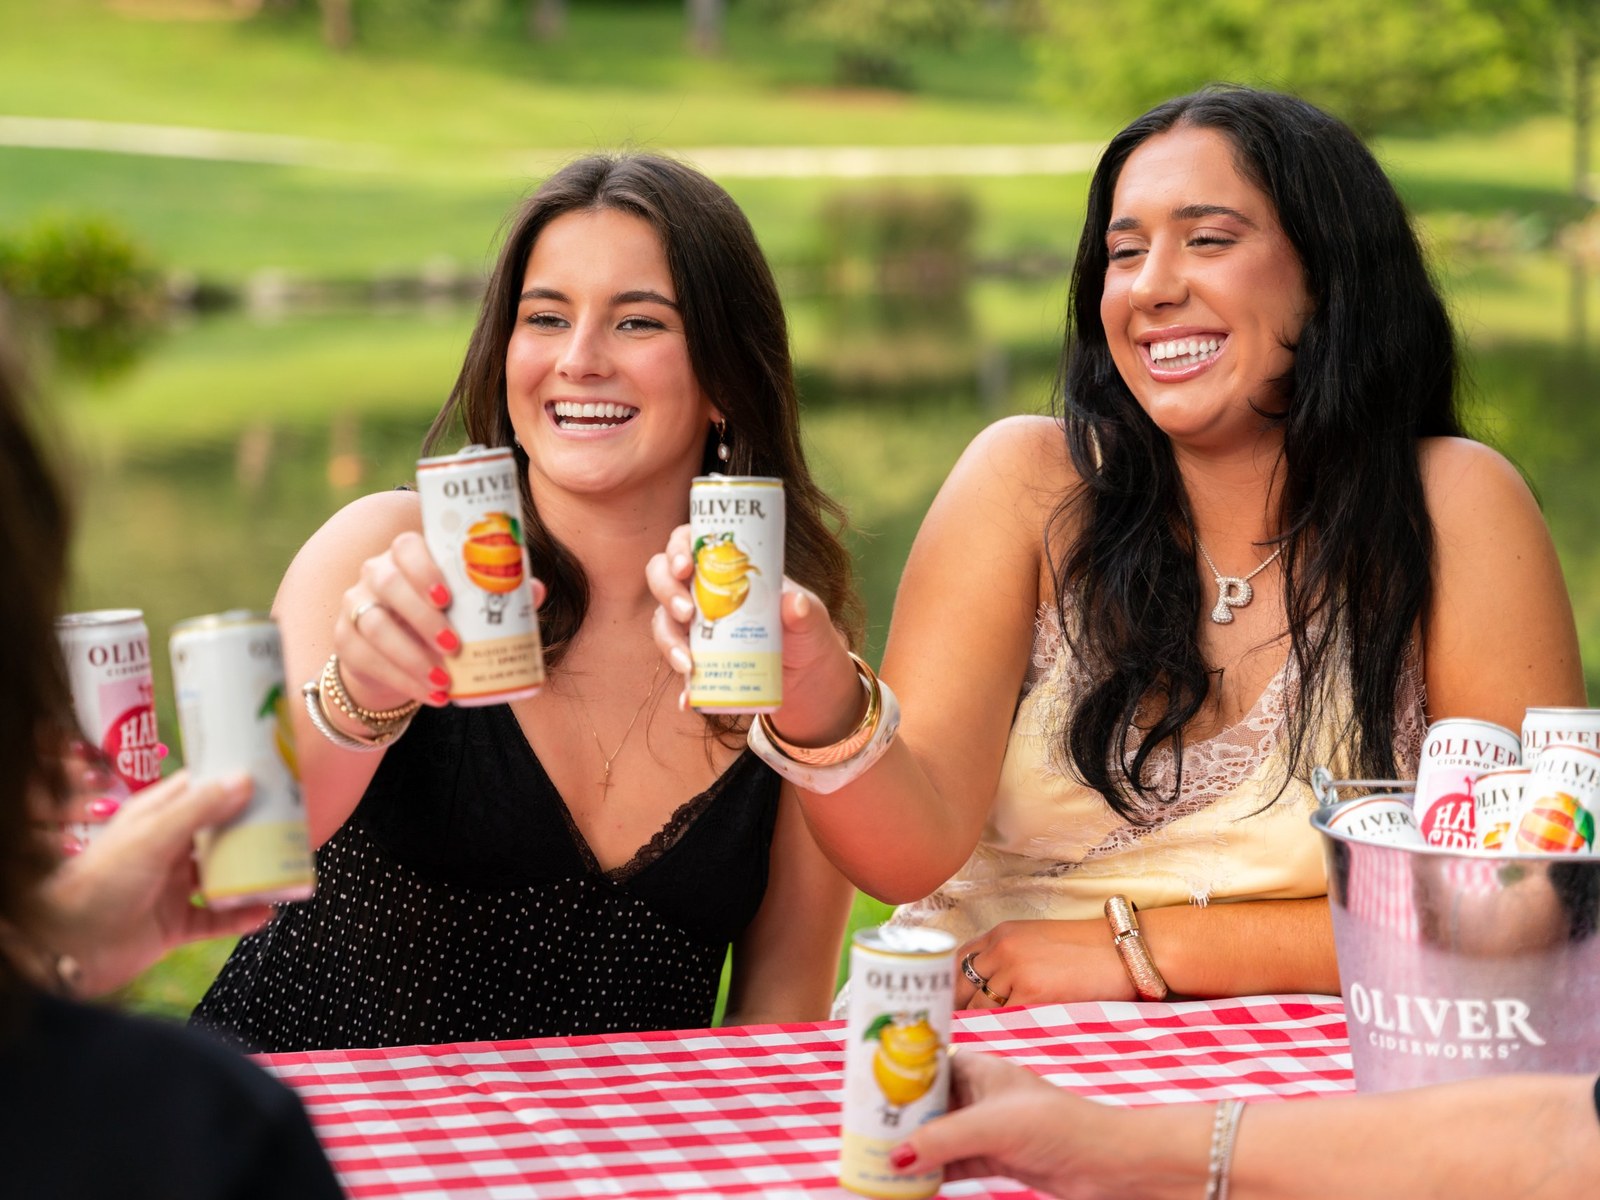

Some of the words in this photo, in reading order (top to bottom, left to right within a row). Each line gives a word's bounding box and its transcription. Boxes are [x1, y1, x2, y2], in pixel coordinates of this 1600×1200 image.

[691, 498, 766, 520] OLIVER
[1212, 576, 1252, 624] P
[1429, 737, 1518, 767] OLIVER
[1346, 811, 1416, 836] LIVER
[1350, 982, 1546, 1046] OLIVER
